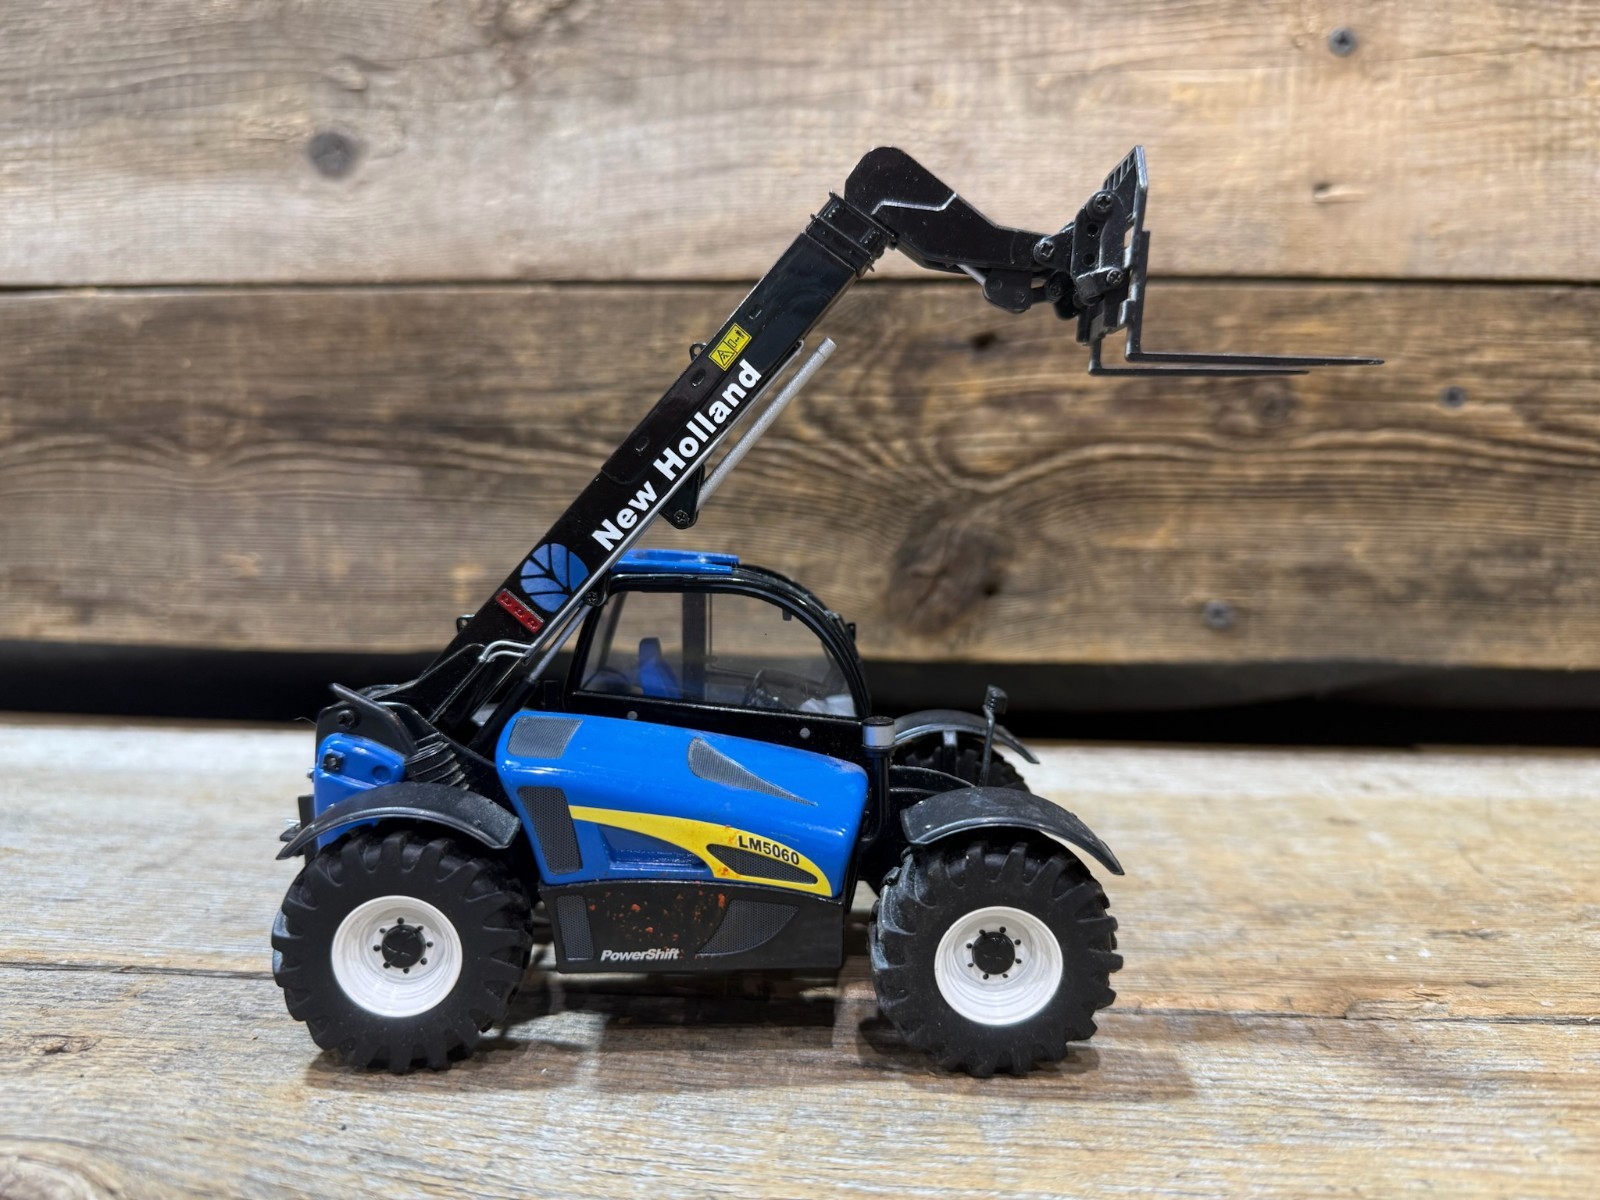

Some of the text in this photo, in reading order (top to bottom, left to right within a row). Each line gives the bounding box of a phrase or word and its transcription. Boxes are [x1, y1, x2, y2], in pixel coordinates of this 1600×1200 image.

[591, 358, 762, 551] New Holland
[738, 835, 800, 866] LM5060
[600, 947, 680, 961] PowerShift
